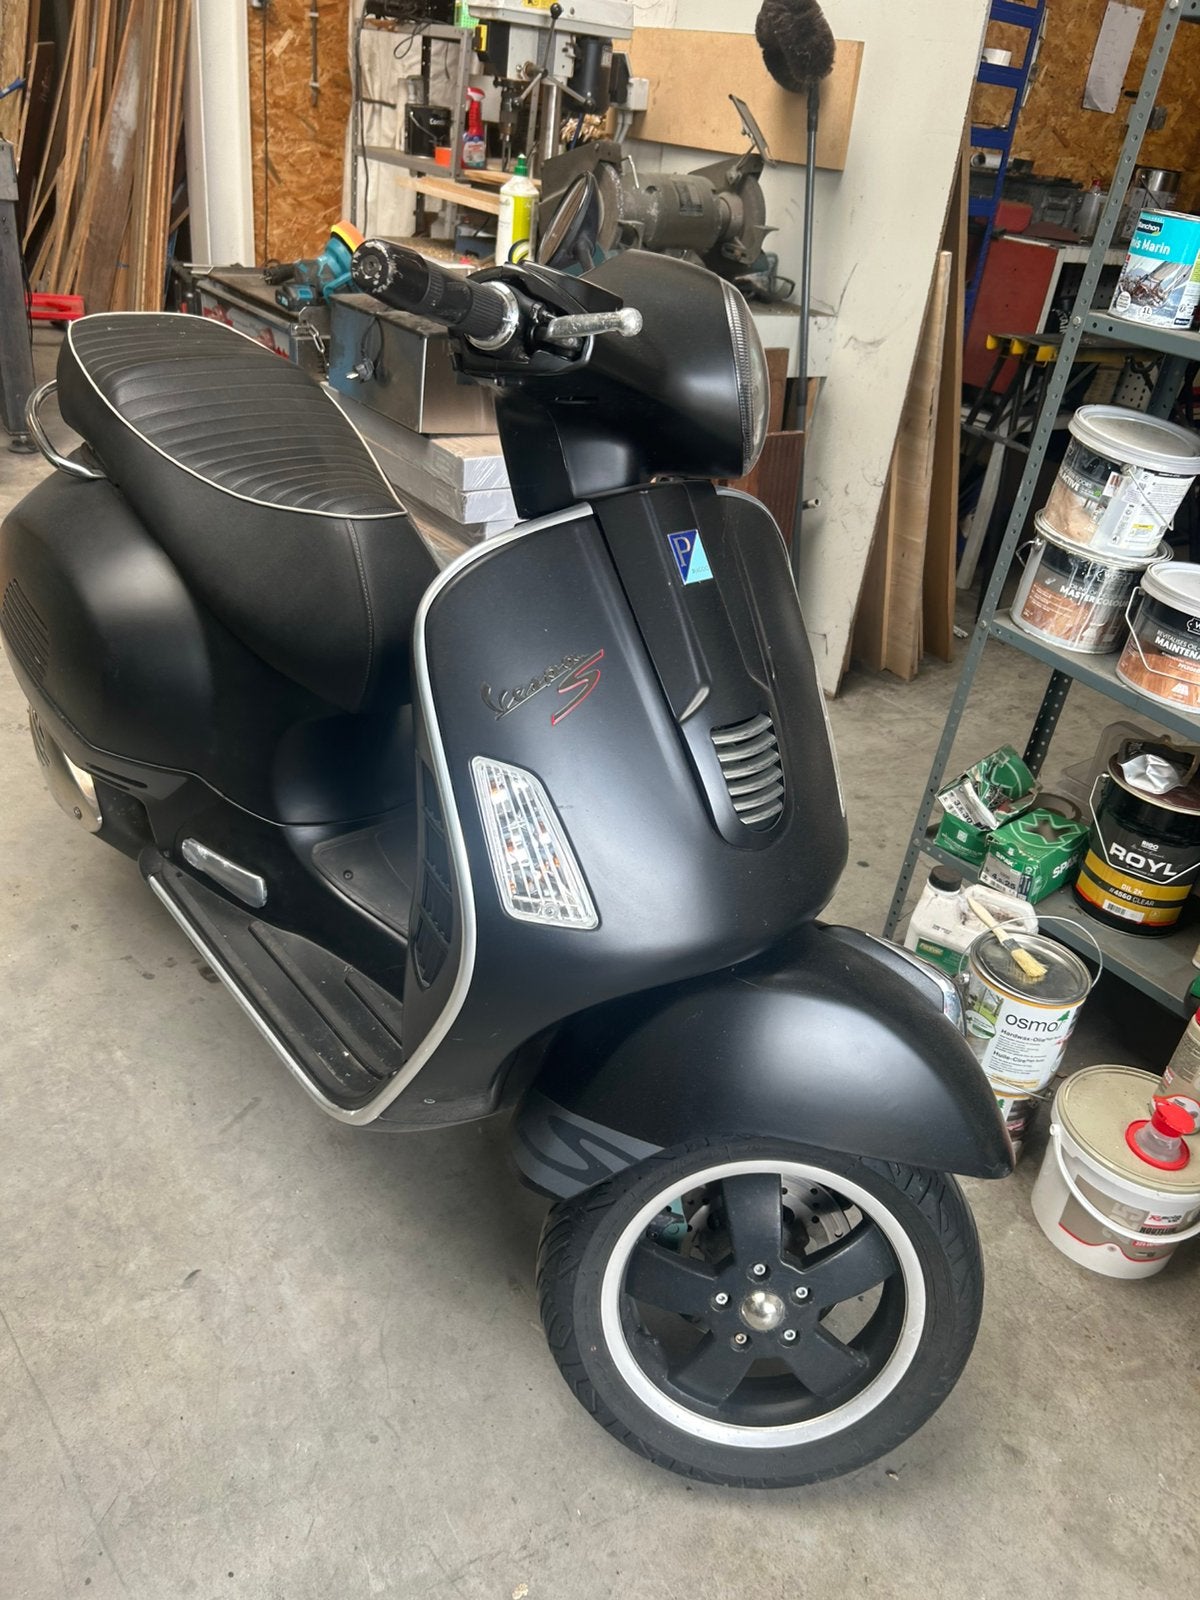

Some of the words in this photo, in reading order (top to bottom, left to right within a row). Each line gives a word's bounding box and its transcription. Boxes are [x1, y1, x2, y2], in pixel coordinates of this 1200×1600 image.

[1141, 239, 1171, 256] Marin
[672, 536, 691, 567] P
[1060, 585, 1096, 603] MASTER
[480, 655, 580, 721] Vespa
[551, 648, 604, 726] S
[1109, 841, 1178, 876] ROYL
[1132, 896, 1155, 907] CLEAR
[1005, 1014, 1059, 1033] osmo
